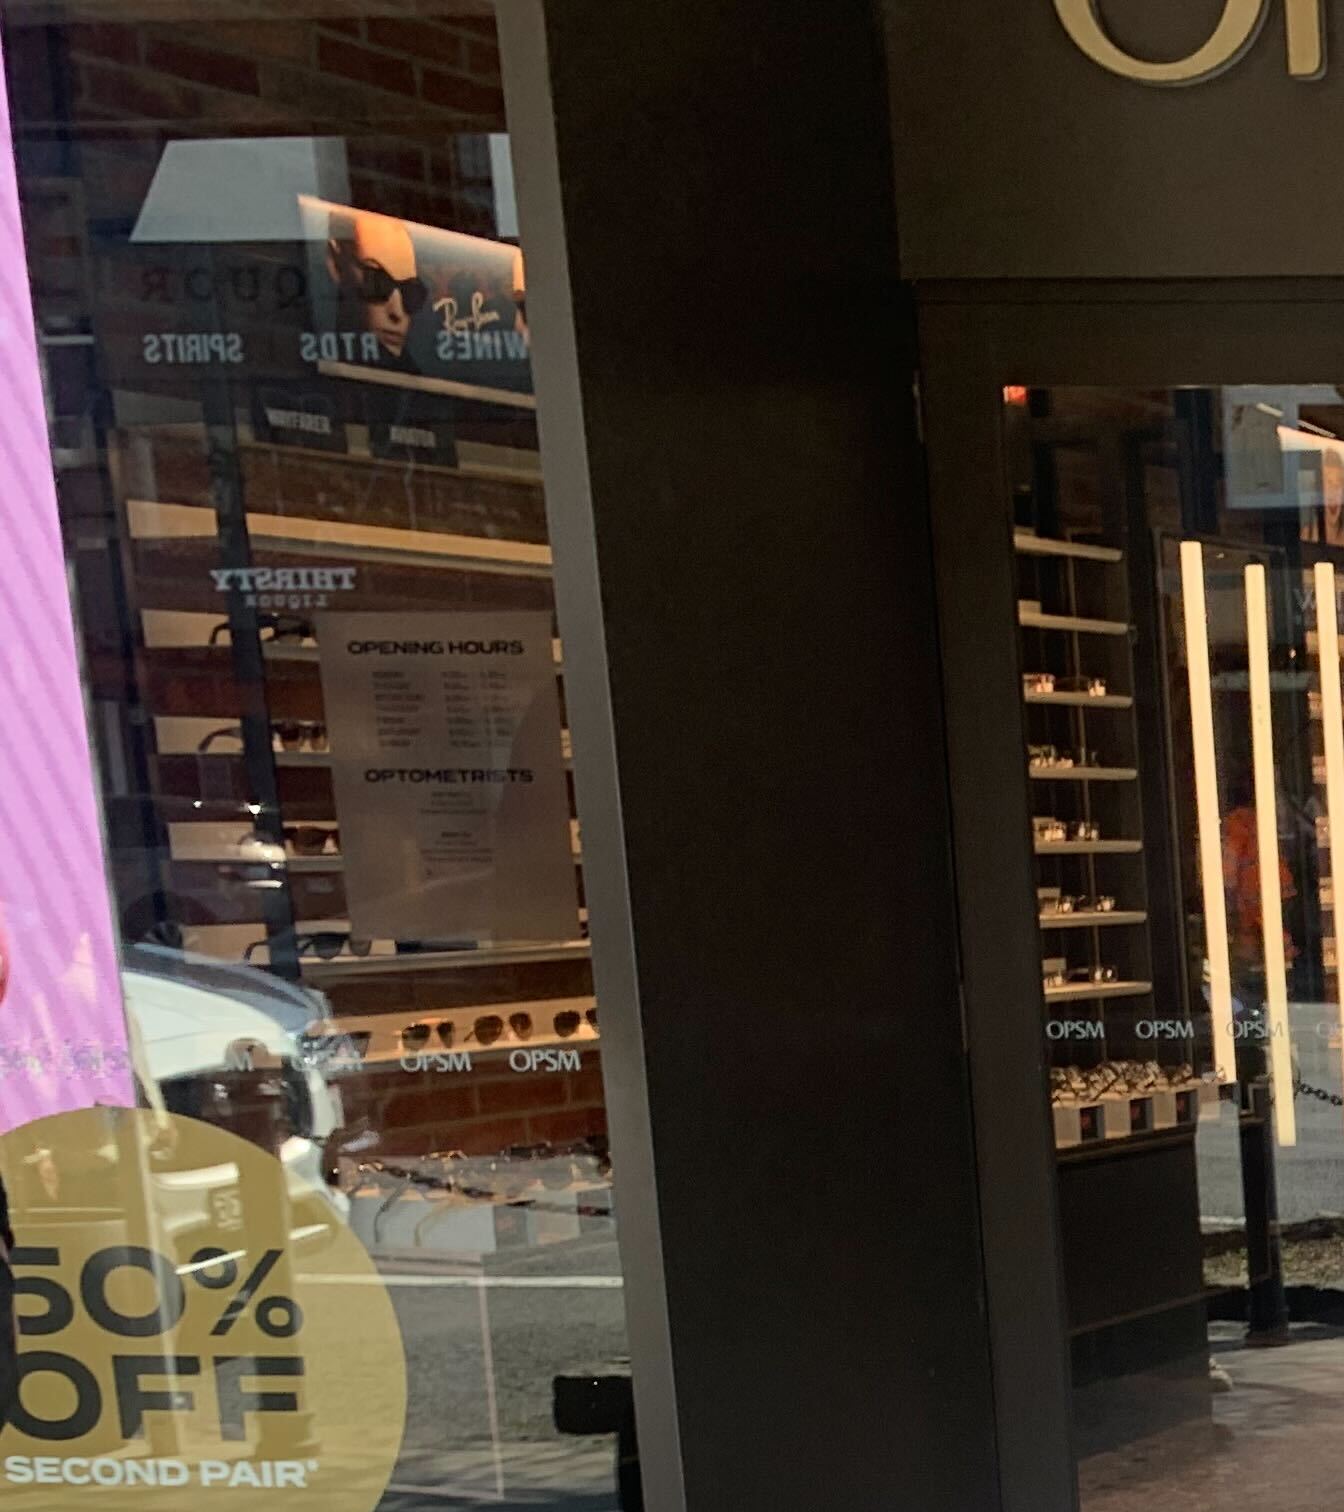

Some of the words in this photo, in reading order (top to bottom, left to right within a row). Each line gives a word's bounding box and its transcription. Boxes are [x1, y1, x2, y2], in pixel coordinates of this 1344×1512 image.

[346, 639, 445, 656] OPENING
[448, 640, 526, 656] HOURS
[364, 768, 534, 783] OPTOMETRISTS
[1046, 1020, 1105, 1040] OPSM
[1135, 1020, 1195, 1040] OPSM
[400, 1050, 473, 1073] OPSM
[509, 1048, 582, 1073] OPSM
[11, 1245, 303, 1338] 50%
[4, 1350, 304, 1441] OFF
[4, 1455, 190, 1486] SECOND
